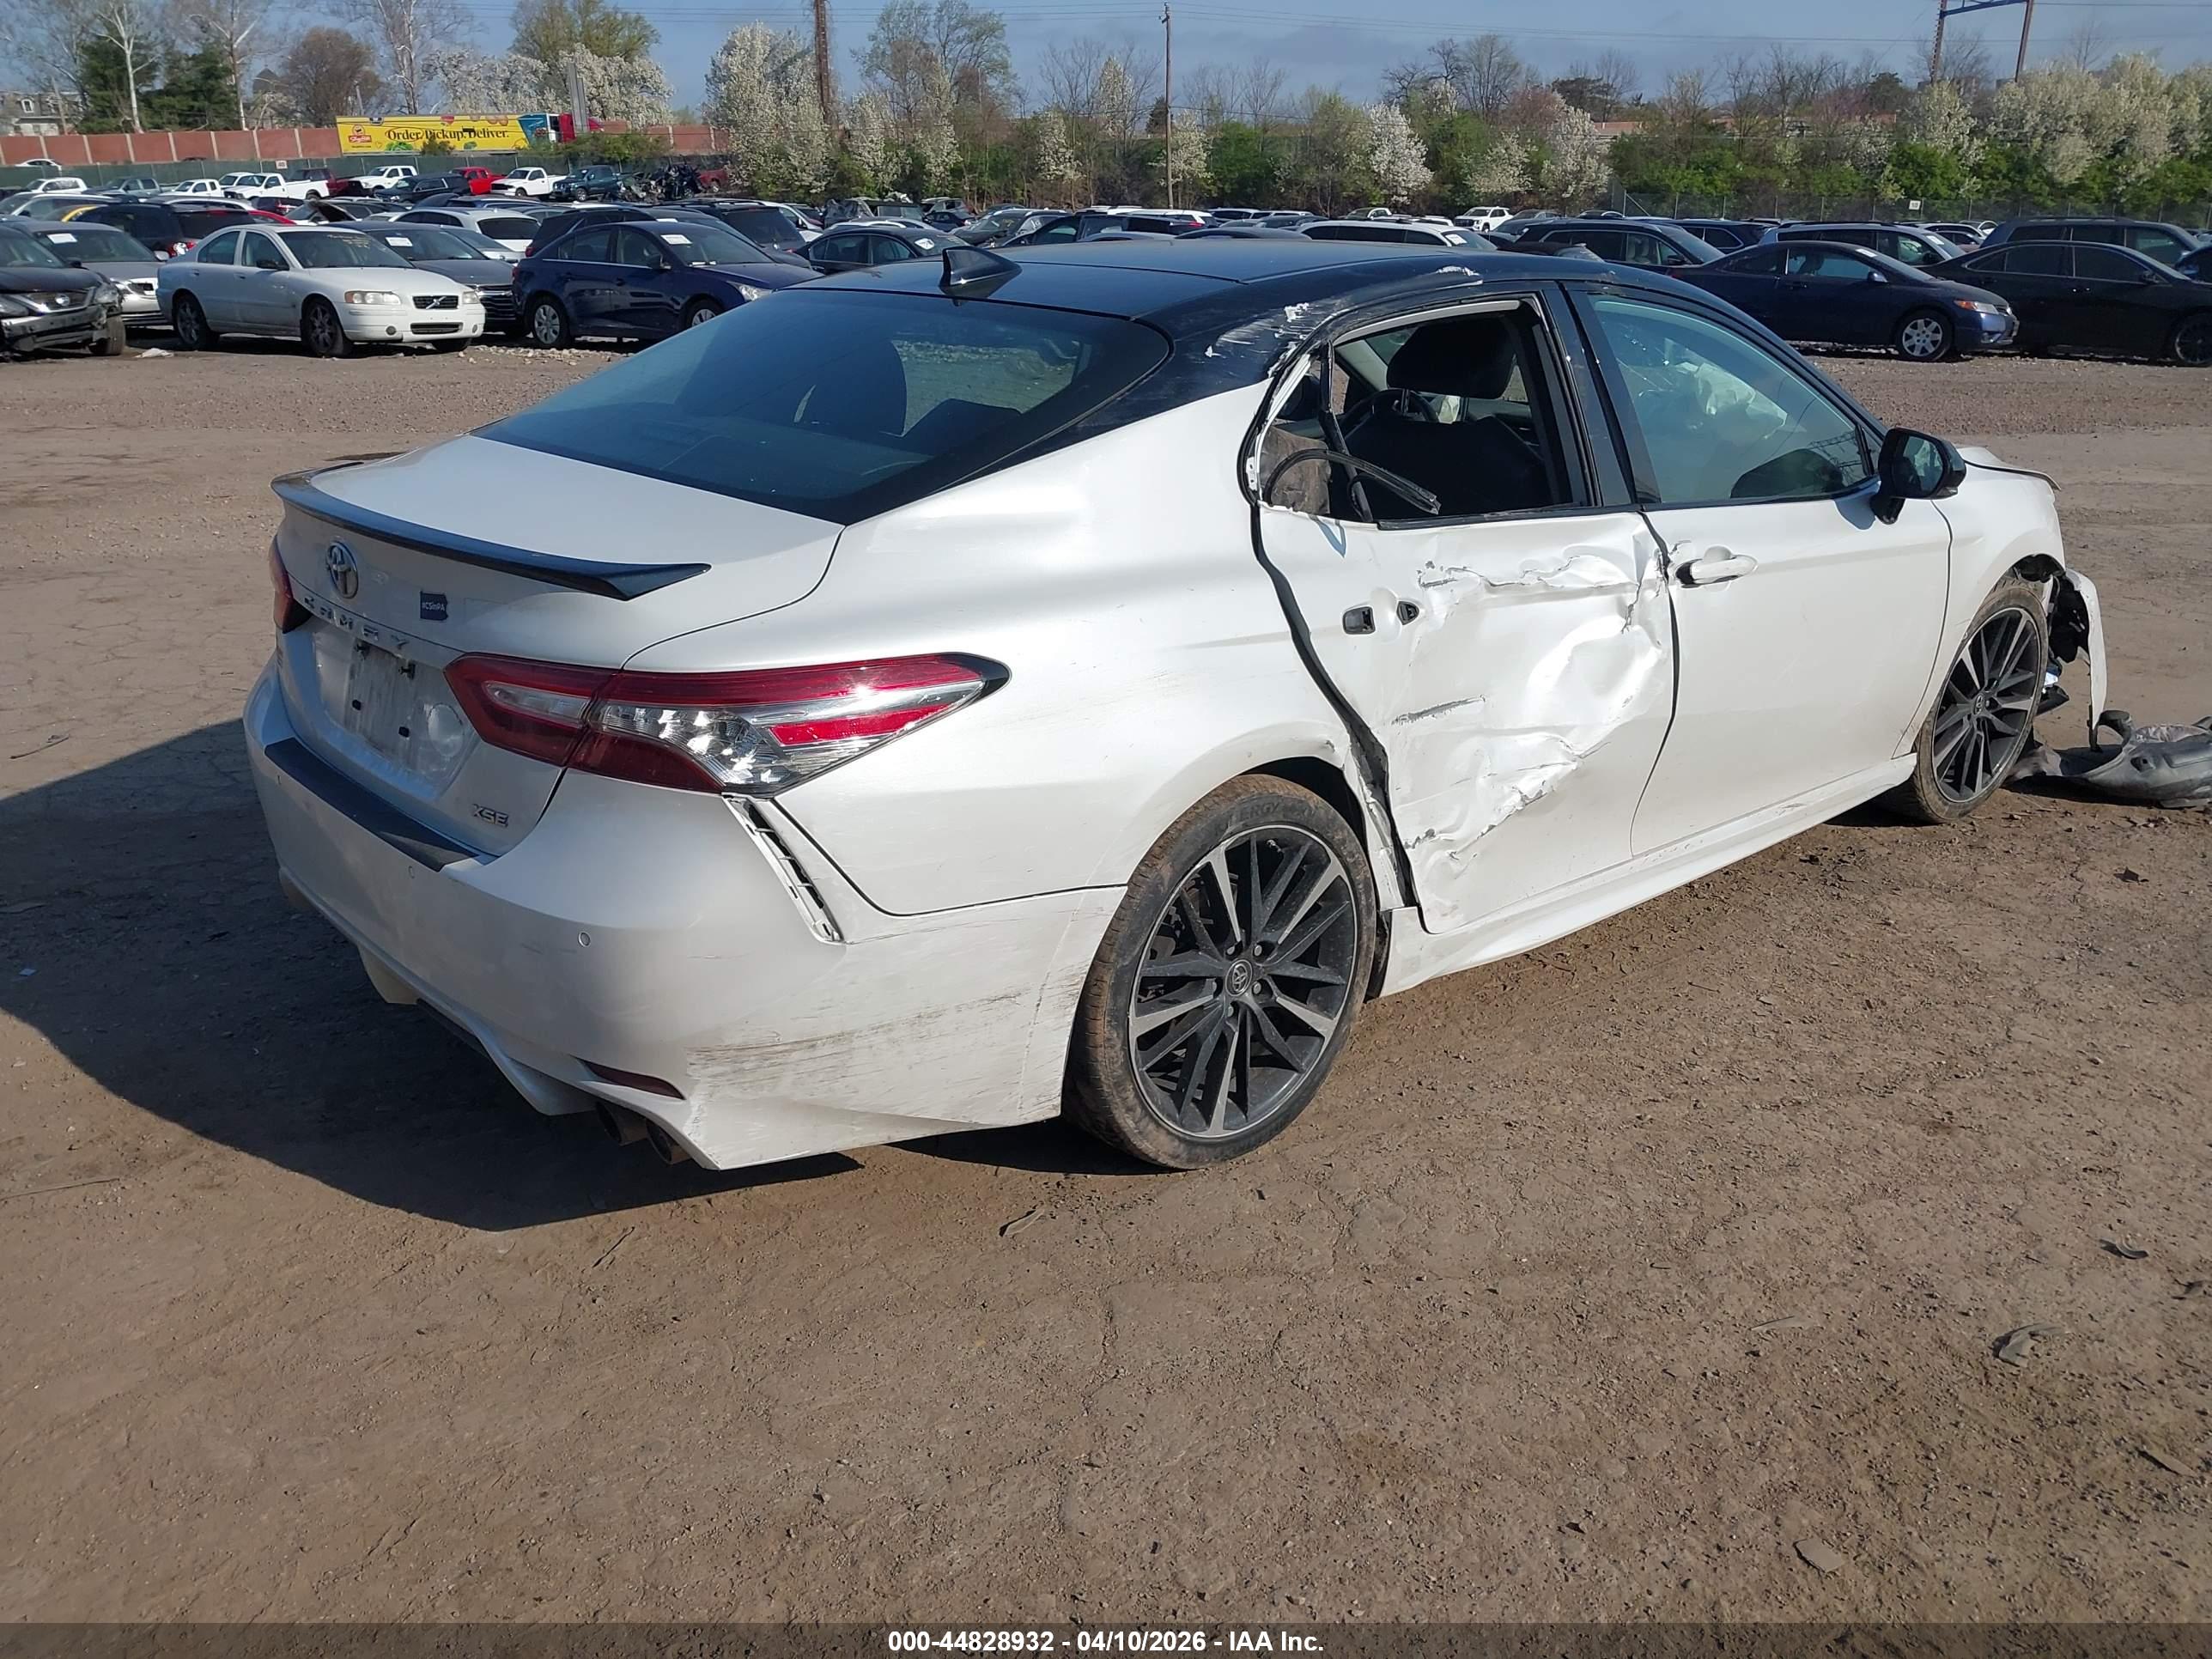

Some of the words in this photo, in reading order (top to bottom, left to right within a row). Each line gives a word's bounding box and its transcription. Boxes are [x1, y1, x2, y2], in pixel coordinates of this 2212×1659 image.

[425, 128, 466, 142] Pickup.
[468, 127, 509, 140] Deliver.
[471, 803, 509, 828] XSE
